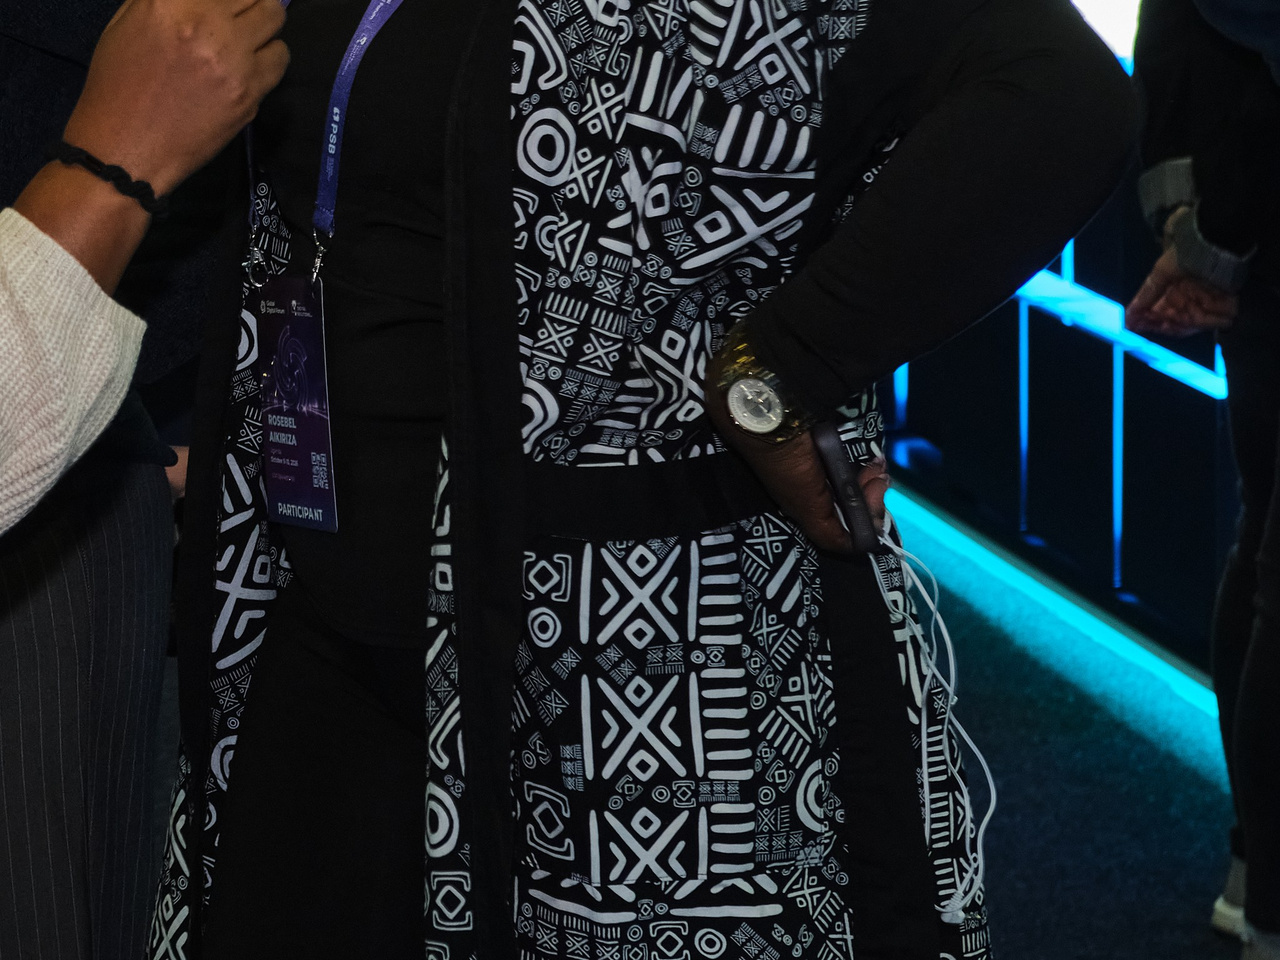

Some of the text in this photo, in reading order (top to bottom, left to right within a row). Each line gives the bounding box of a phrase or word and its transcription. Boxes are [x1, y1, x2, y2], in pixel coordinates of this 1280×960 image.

[327, 123, 339, 155] PSB
[268, 414, 297, 429] ROSEBEL
[277, 502, 323, 522] PARTICIPANT
